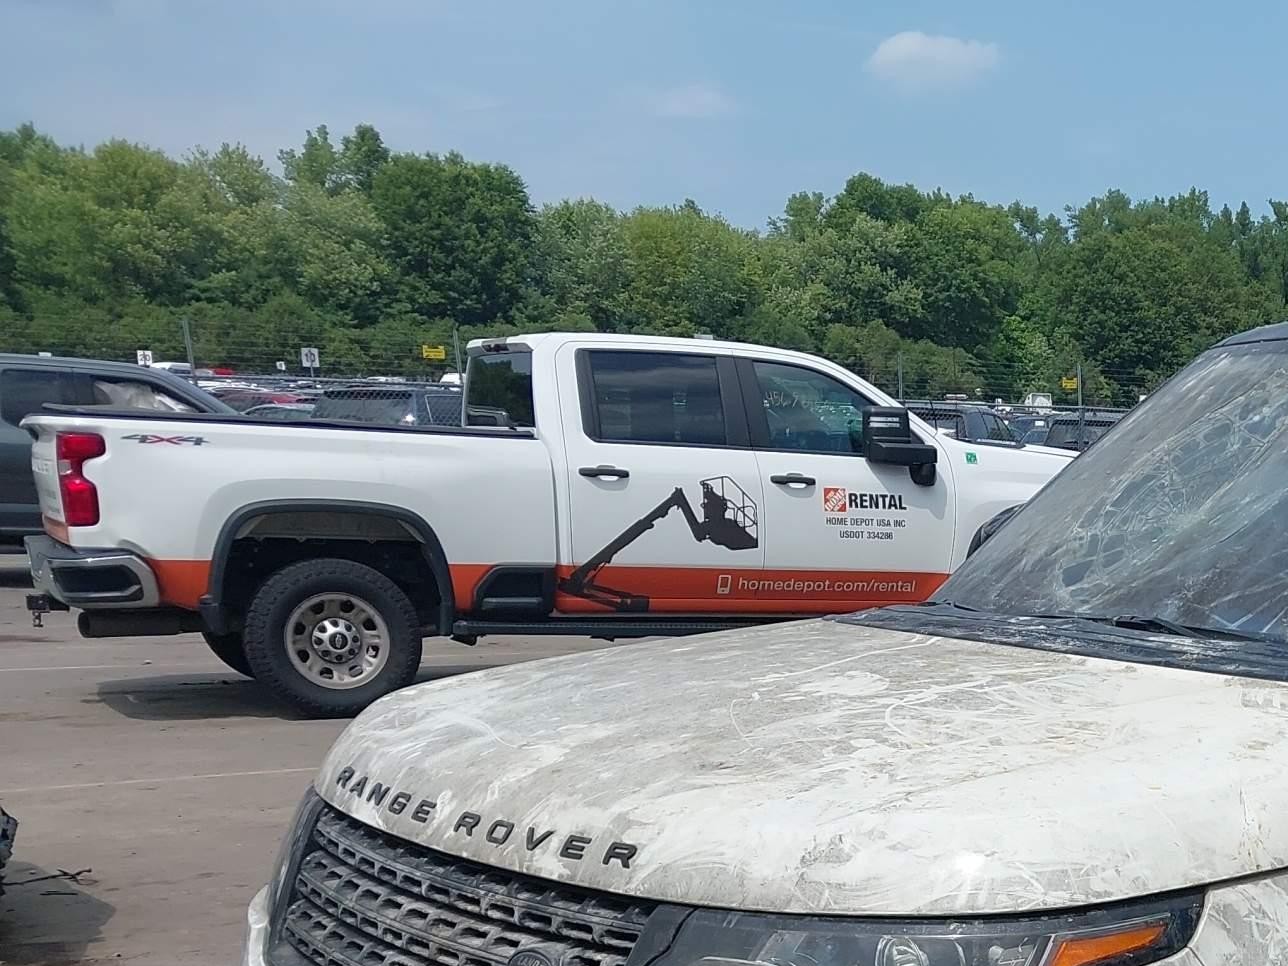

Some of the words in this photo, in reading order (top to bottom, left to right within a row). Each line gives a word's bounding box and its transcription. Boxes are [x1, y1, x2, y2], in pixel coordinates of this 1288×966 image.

[304, 351, 316, 363] 10
[824, 488, 846, 511] HOME
[848, 493, 907, 510] RENTAL
[826, 517, 848, 526] HOME
[850, 518, 874, 526] DEPOT
[877, 519, 891, 527] USA
[894, 520, 906, 528] INC
[840, 531, 864, 539] USDOT
[738, 577, 916, 593] homedepot.com/rental
[336, 766, 437, 823] RANGE
[453, 811, 638, 869] ROVER
